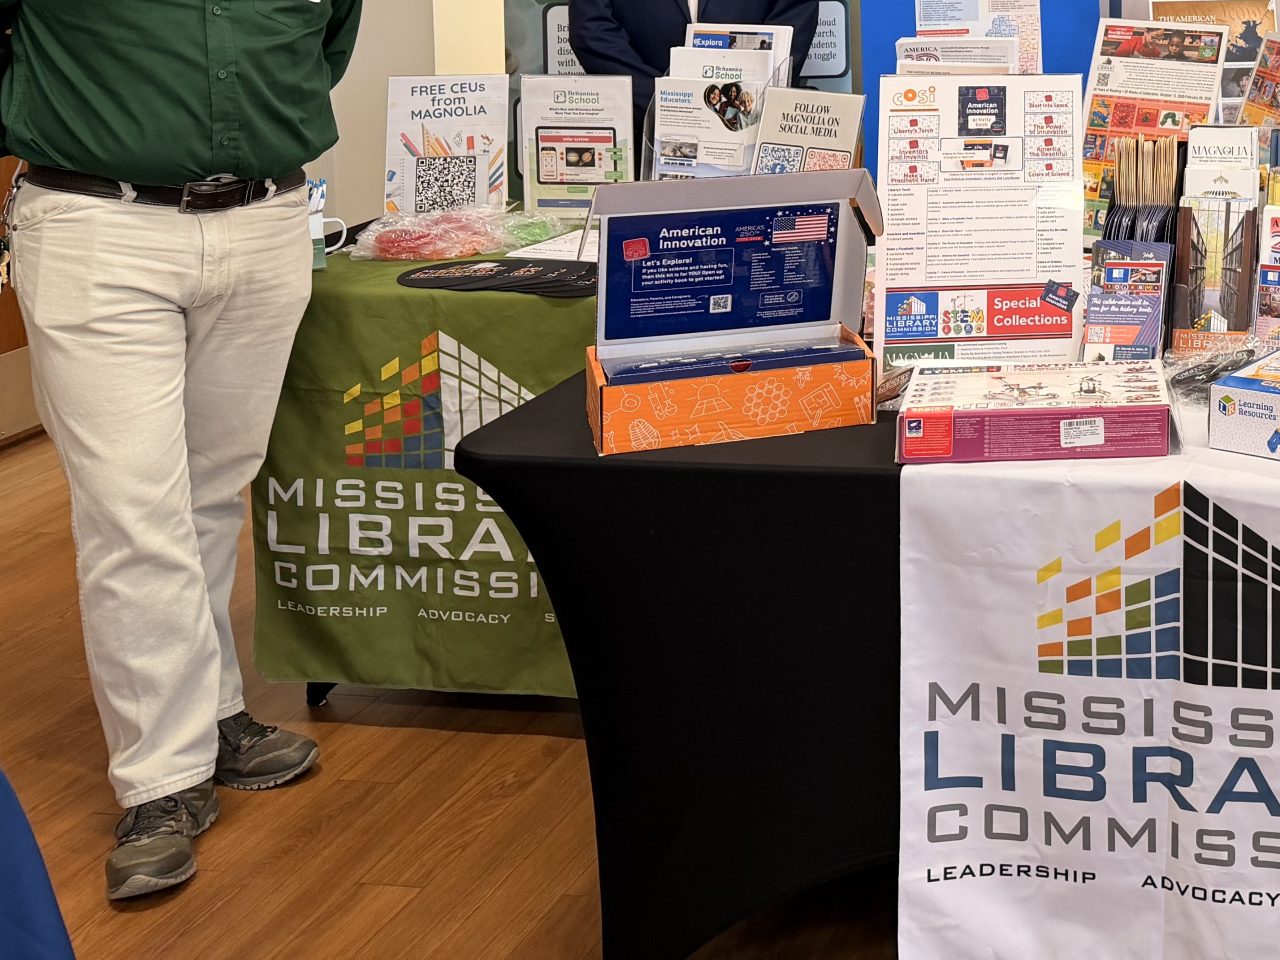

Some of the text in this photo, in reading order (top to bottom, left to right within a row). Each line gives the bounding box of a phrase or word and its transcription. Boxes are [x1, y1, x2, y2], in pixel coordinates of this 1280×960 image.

[715, 71, 742, 80] School
[411, 82, 485, 97] FREE CEUs
[430, 95, 468, 108] from
[568, 96, 600, 104] School
[411, 105, 487, 120] MAGNOLIA
[794, 102, 831, 115] FOLLOW
[781, 112, 840, 127] MAGNOLIA ON
[779, 123, 837, 138] SOCIAL MEDIA
[1191, 145, 1249, 156] MAGNOLIA
[660, 226, 720, 238] American
[660, 236, 726, 249] Innovation
[994, 297, 1040, 311] Special
[994, 314, 1067, 326] Collections
[1238, 400, 1274, 413] Learning
[1238, 408, 1276, 421] Resources
[277, 599, 511, 624] LEADERSHIP ADVOCACY
[927, 862, 1096, 883] LEADERSHIP
[1141, 874, 1280, 907] ADVOCACY
